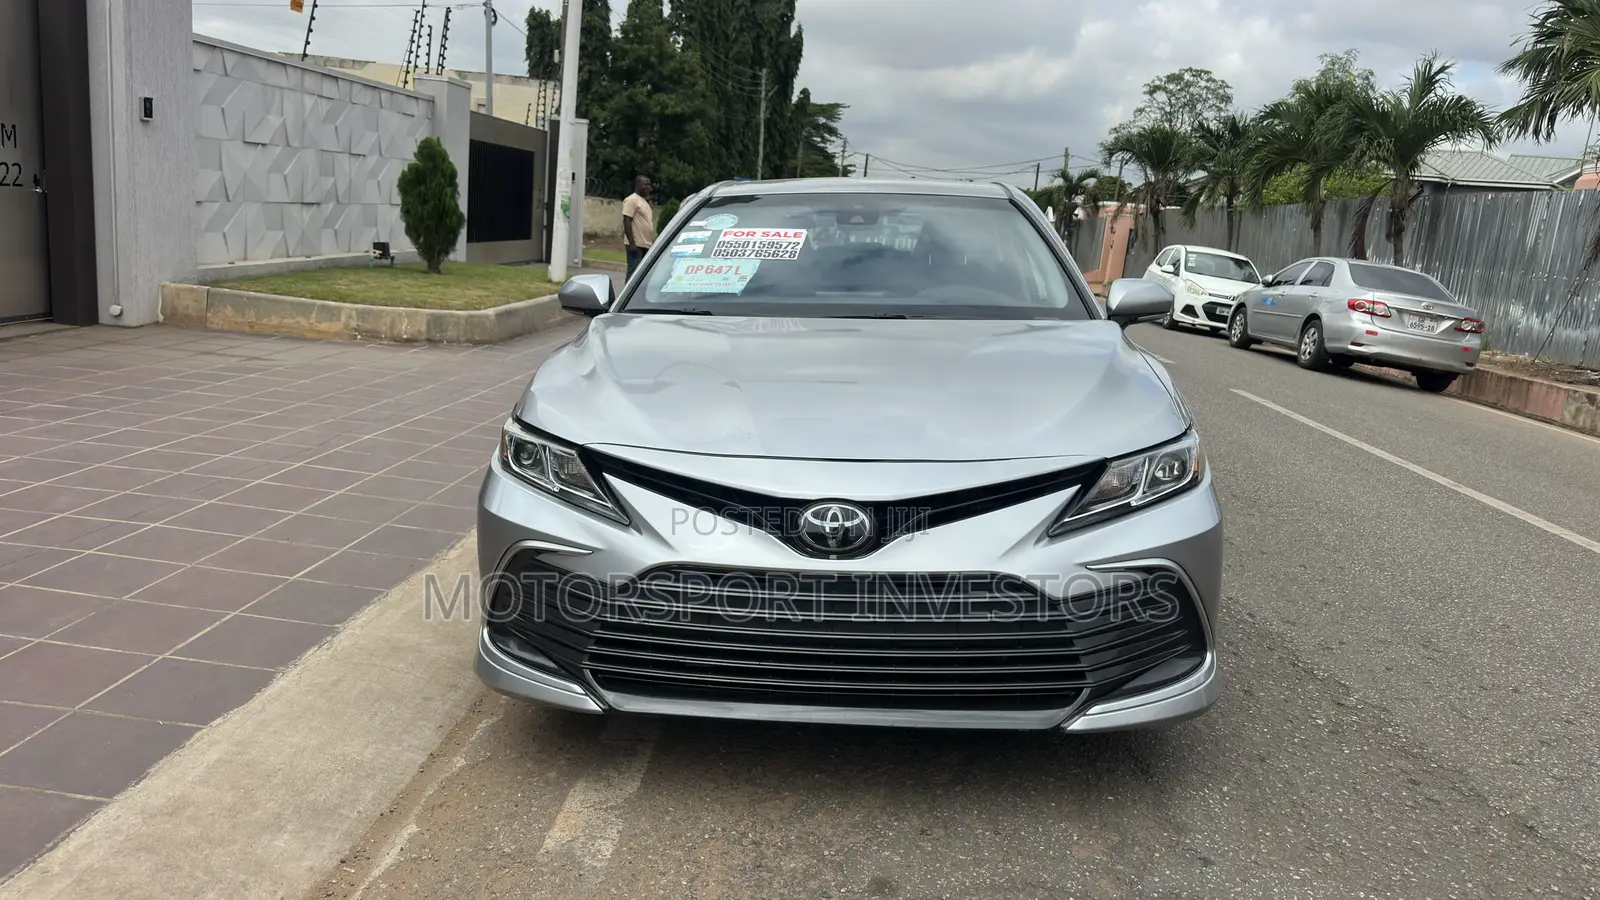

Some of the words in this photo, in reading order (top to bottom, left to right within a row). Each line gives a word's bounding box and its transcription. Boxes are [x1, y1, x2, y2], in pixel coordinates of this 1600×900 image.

[760, 231, 804, 239] SALE
[717, 240, 801, 250] 0550159572
[713, 249, 798, 259] 0503765628
[684, 265, 704, 275] DP
[704, 265, 732, 275] 647
[734, 265, 742, 275] L
